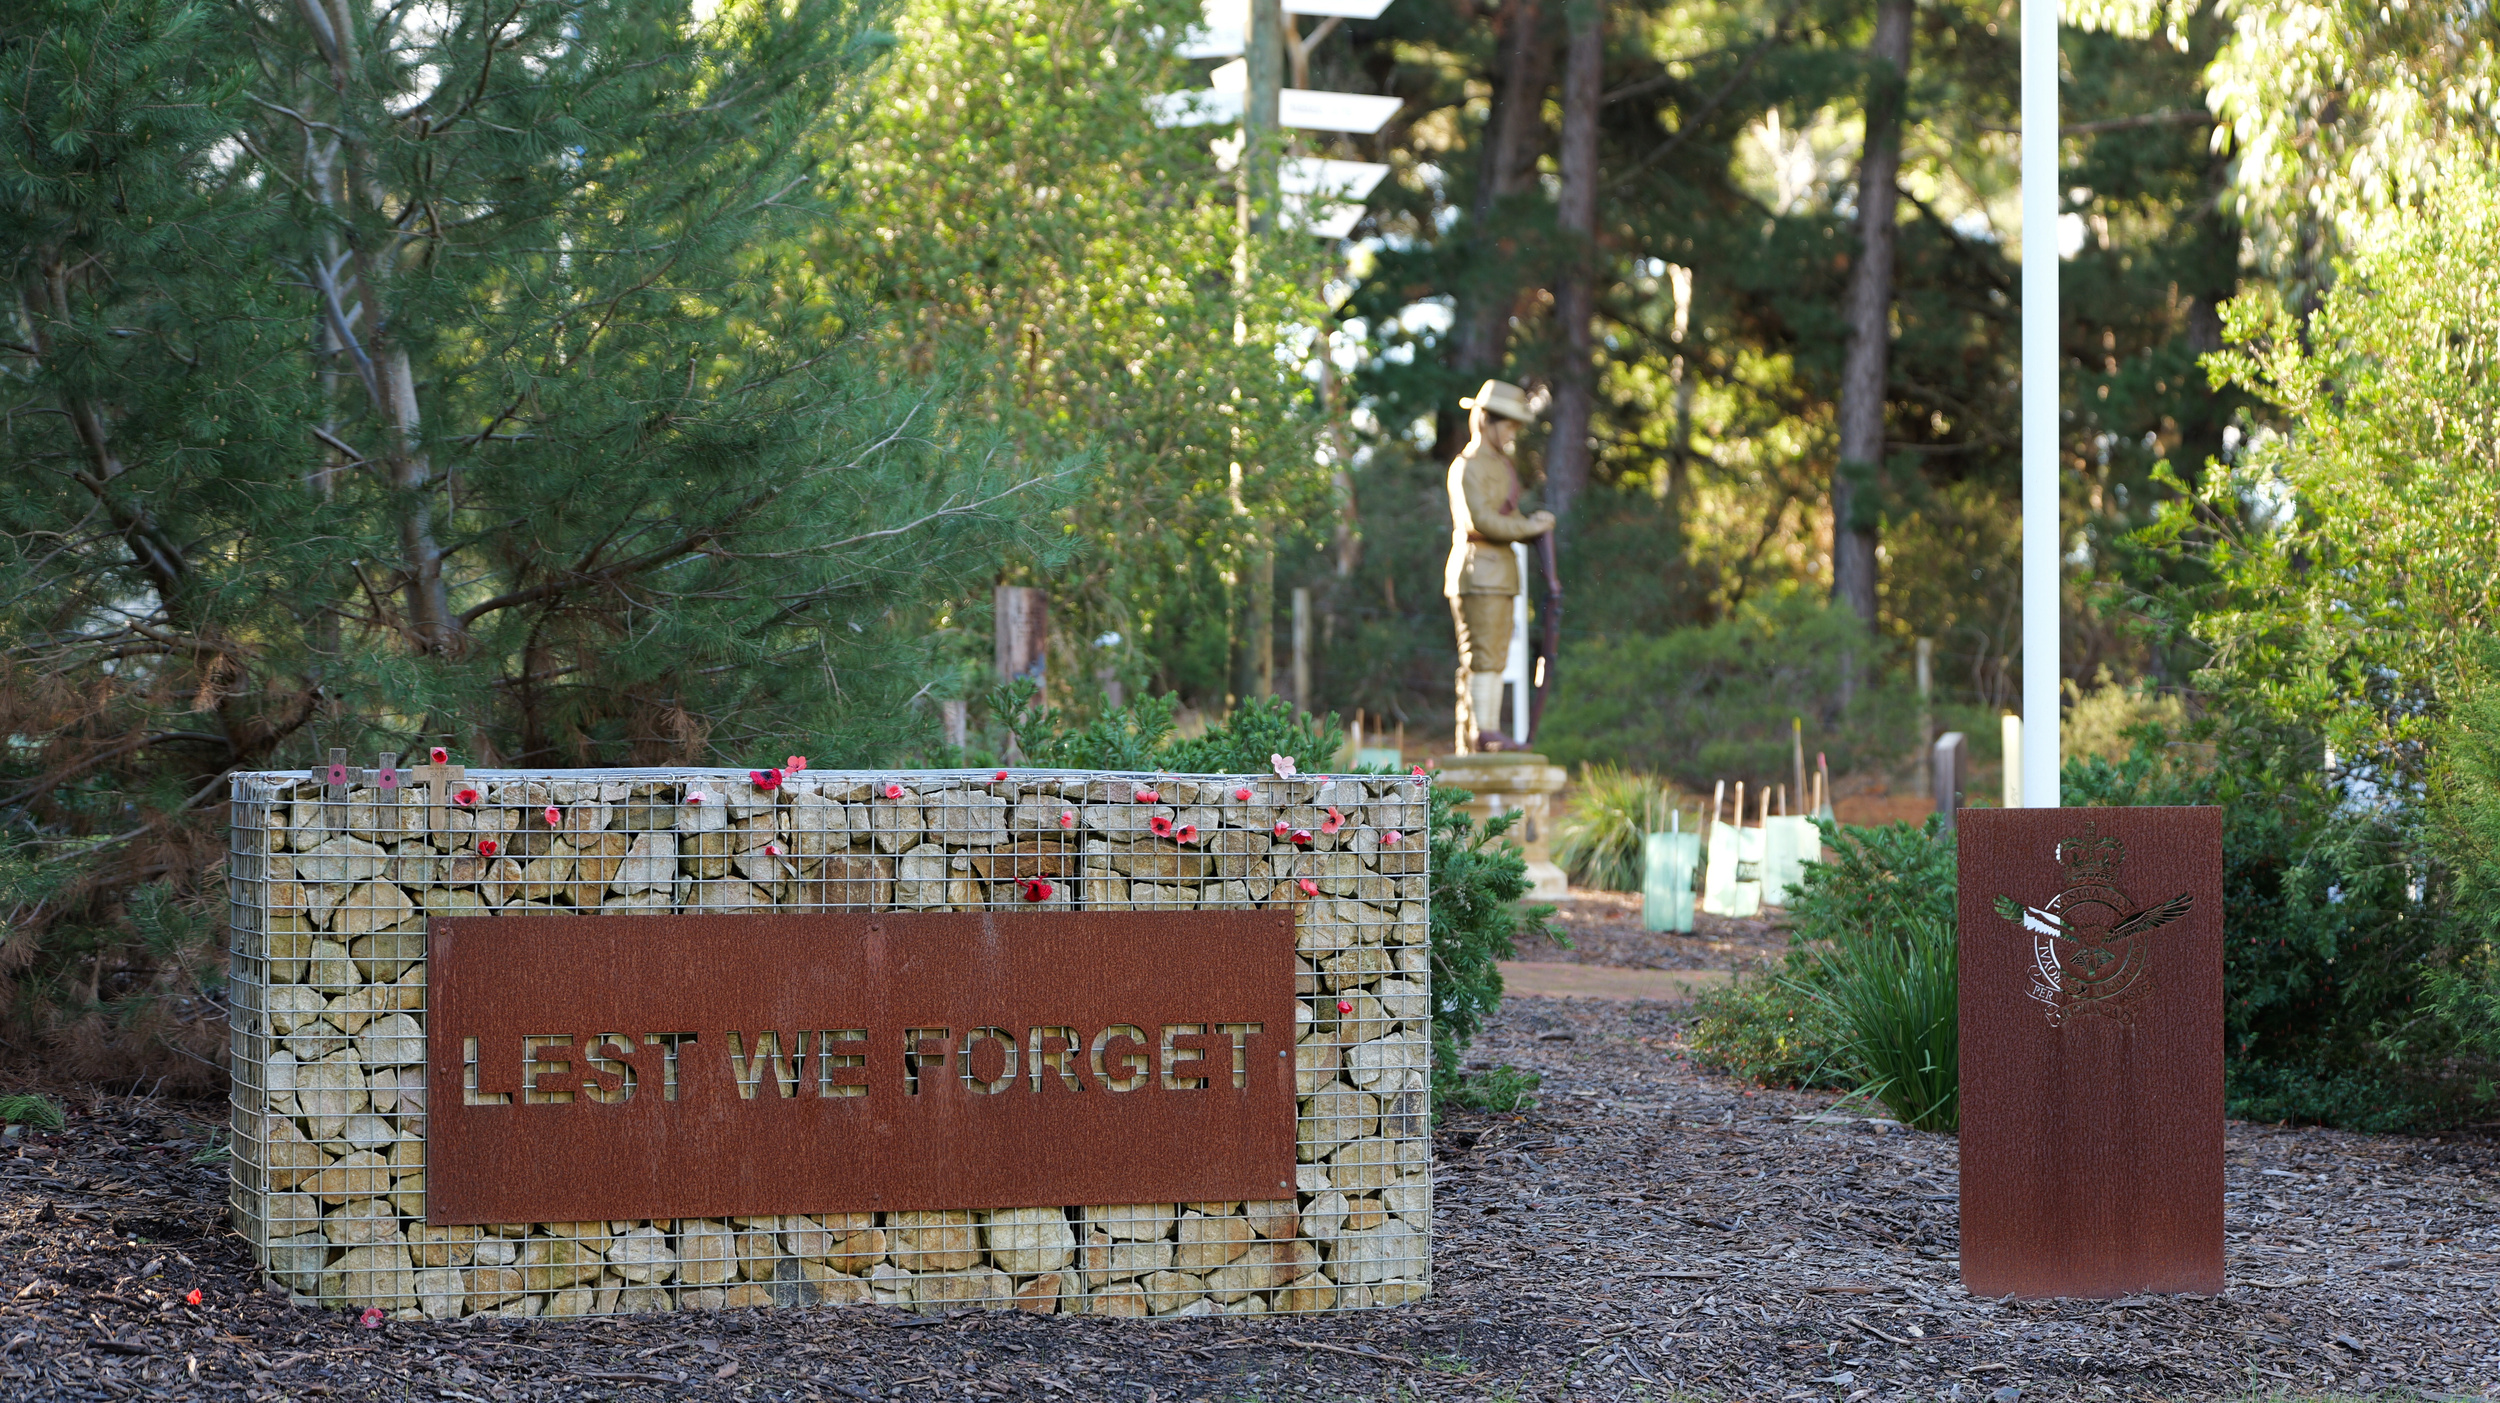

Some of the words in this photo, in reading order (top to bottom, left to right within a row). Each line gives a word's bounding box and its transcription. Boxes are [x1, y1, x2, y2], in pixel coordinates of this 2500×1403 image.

[2038, 943, 2061, 984] ROYAL
[2032, 985, 2054, 1001] PER
[463, 1033, 699, 1105] LEST
[726, 1030, 870, 1099] WE
[904, 1024, 1265, 1095] FORGET
